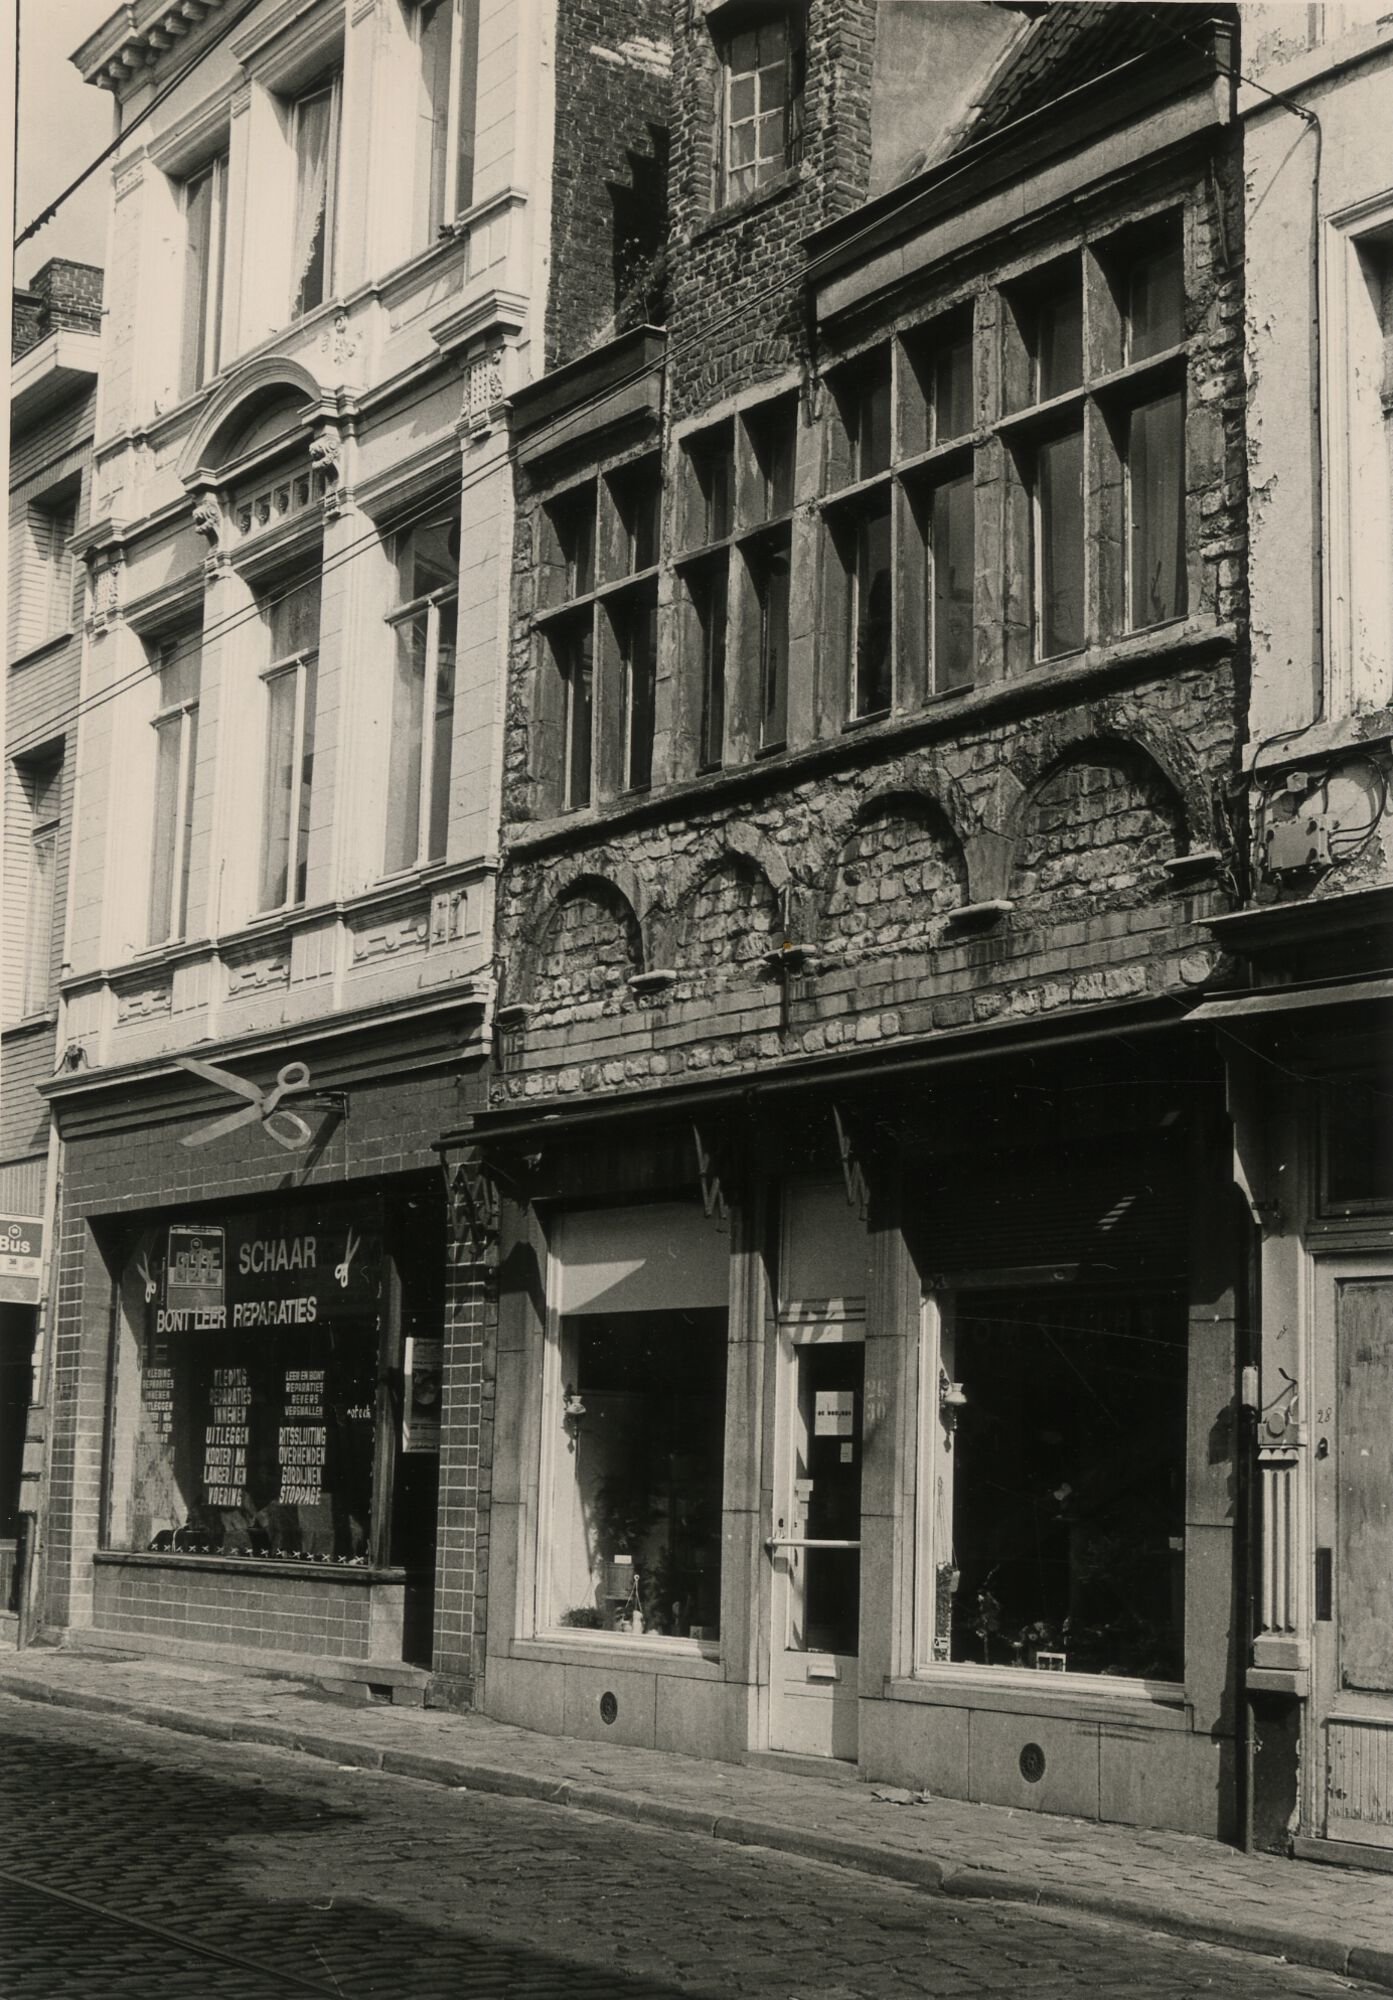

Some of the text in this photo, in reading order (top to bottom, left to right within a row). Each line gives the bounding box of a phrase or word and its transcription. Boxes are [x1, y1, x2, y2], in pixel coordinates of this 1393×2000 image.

[0, 1235, 31, 1253] Bus
[239, 1236, 317, 1274] SCHAAR
[157, 1296, 317, 1333] BONT LEER REPARATIES
[209, 1386, 252, 1405] REPARATIES
[285, 1382, 324, 1393] REPARATIES
[291, 1394, 319, 1404] REVERS
[1317, 1407, 1332, 1424] 28
[205, 1426, 249, 1445] UITLEGGEN
[278, 1426, 327, 1445] RITSSLUITING
[281, 1466, 322, 1485] GORDIJNEN
[208, 1486, 242, 1506] VOERING
[279, 1485, 321, 1505] STOPPAGE
